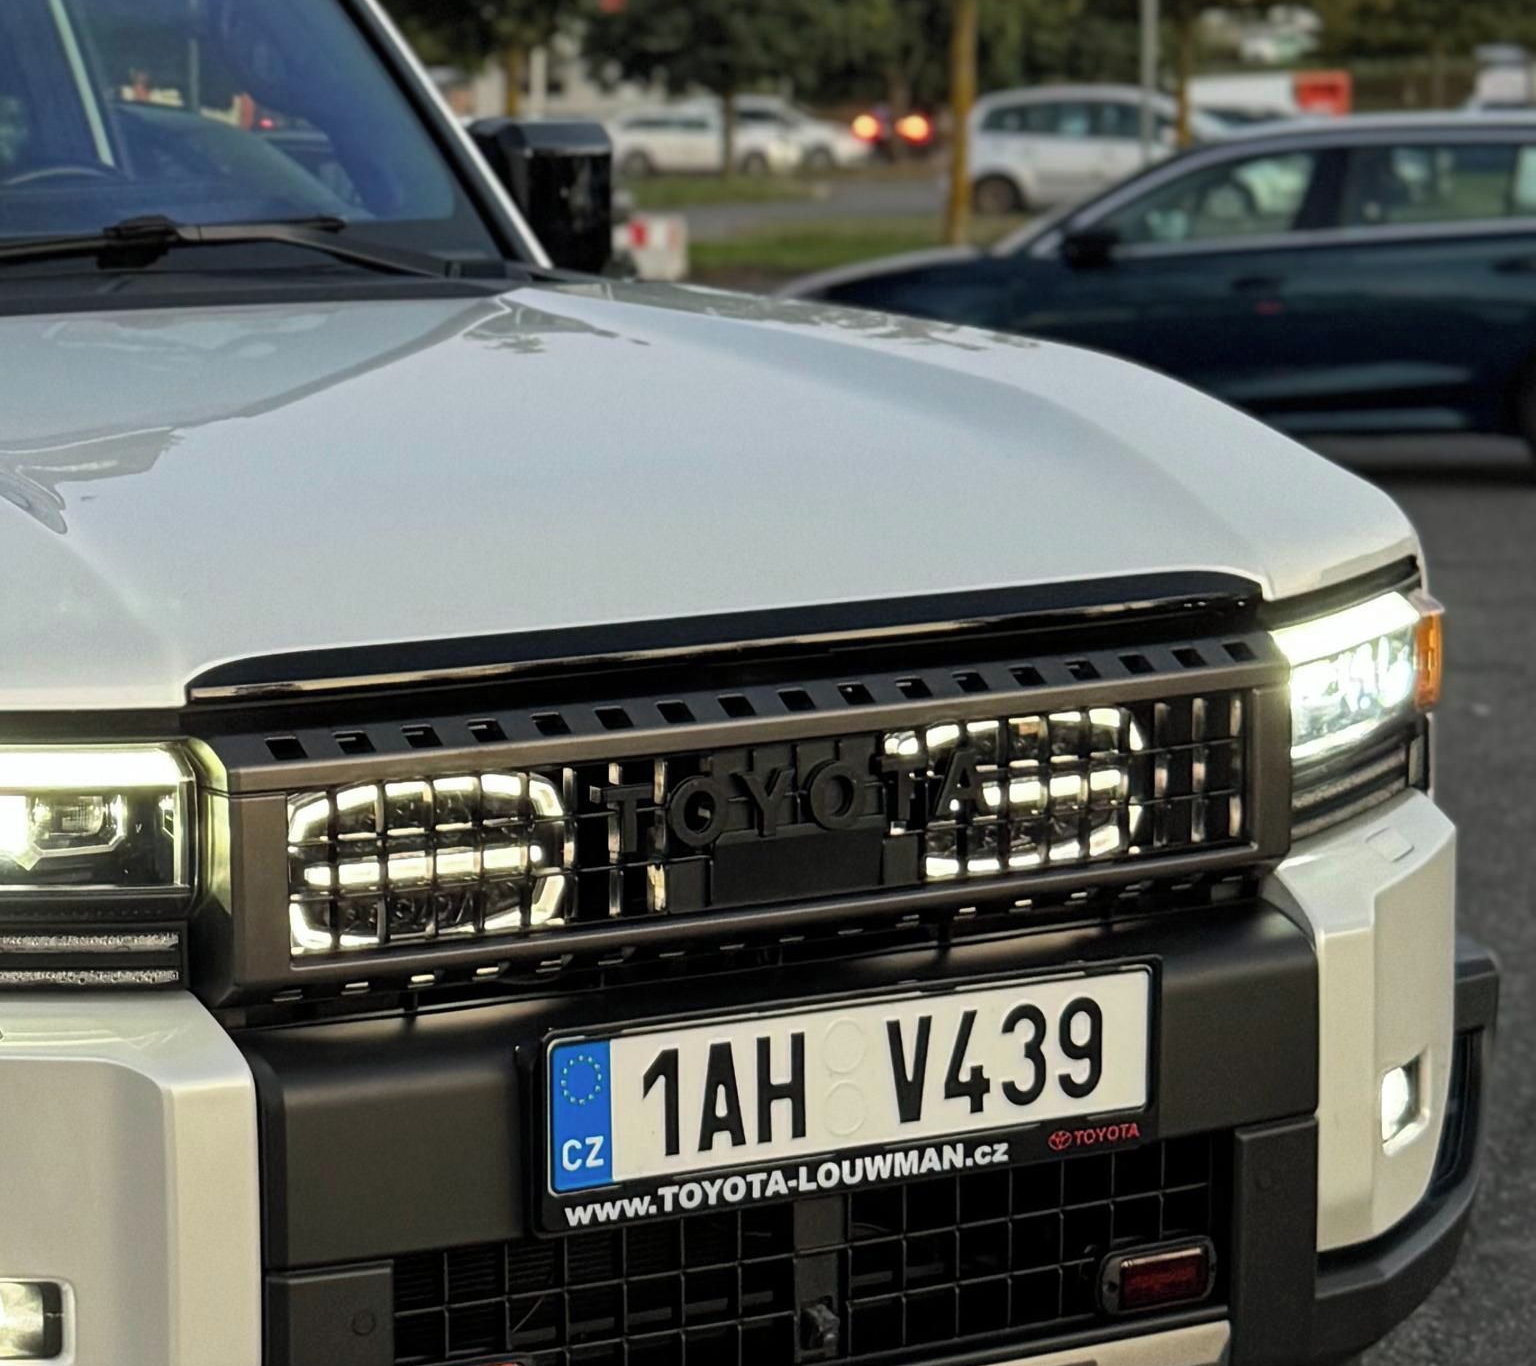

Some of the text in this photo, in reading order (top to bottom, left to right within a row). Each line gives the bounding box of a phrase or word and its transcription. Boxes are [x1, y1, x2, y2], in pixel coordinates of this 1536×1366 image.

[602, 747, 990, 854] TOYOTA
[642, 995, 1104, 1157] 1AH V439
[561, 1135, 605, 1172] CZ
[1074, 1123, 1140, 1146] TOYOTA
[565, 1141, 1010, 1227] www.TOYOTA-LOUWMAN.cz
